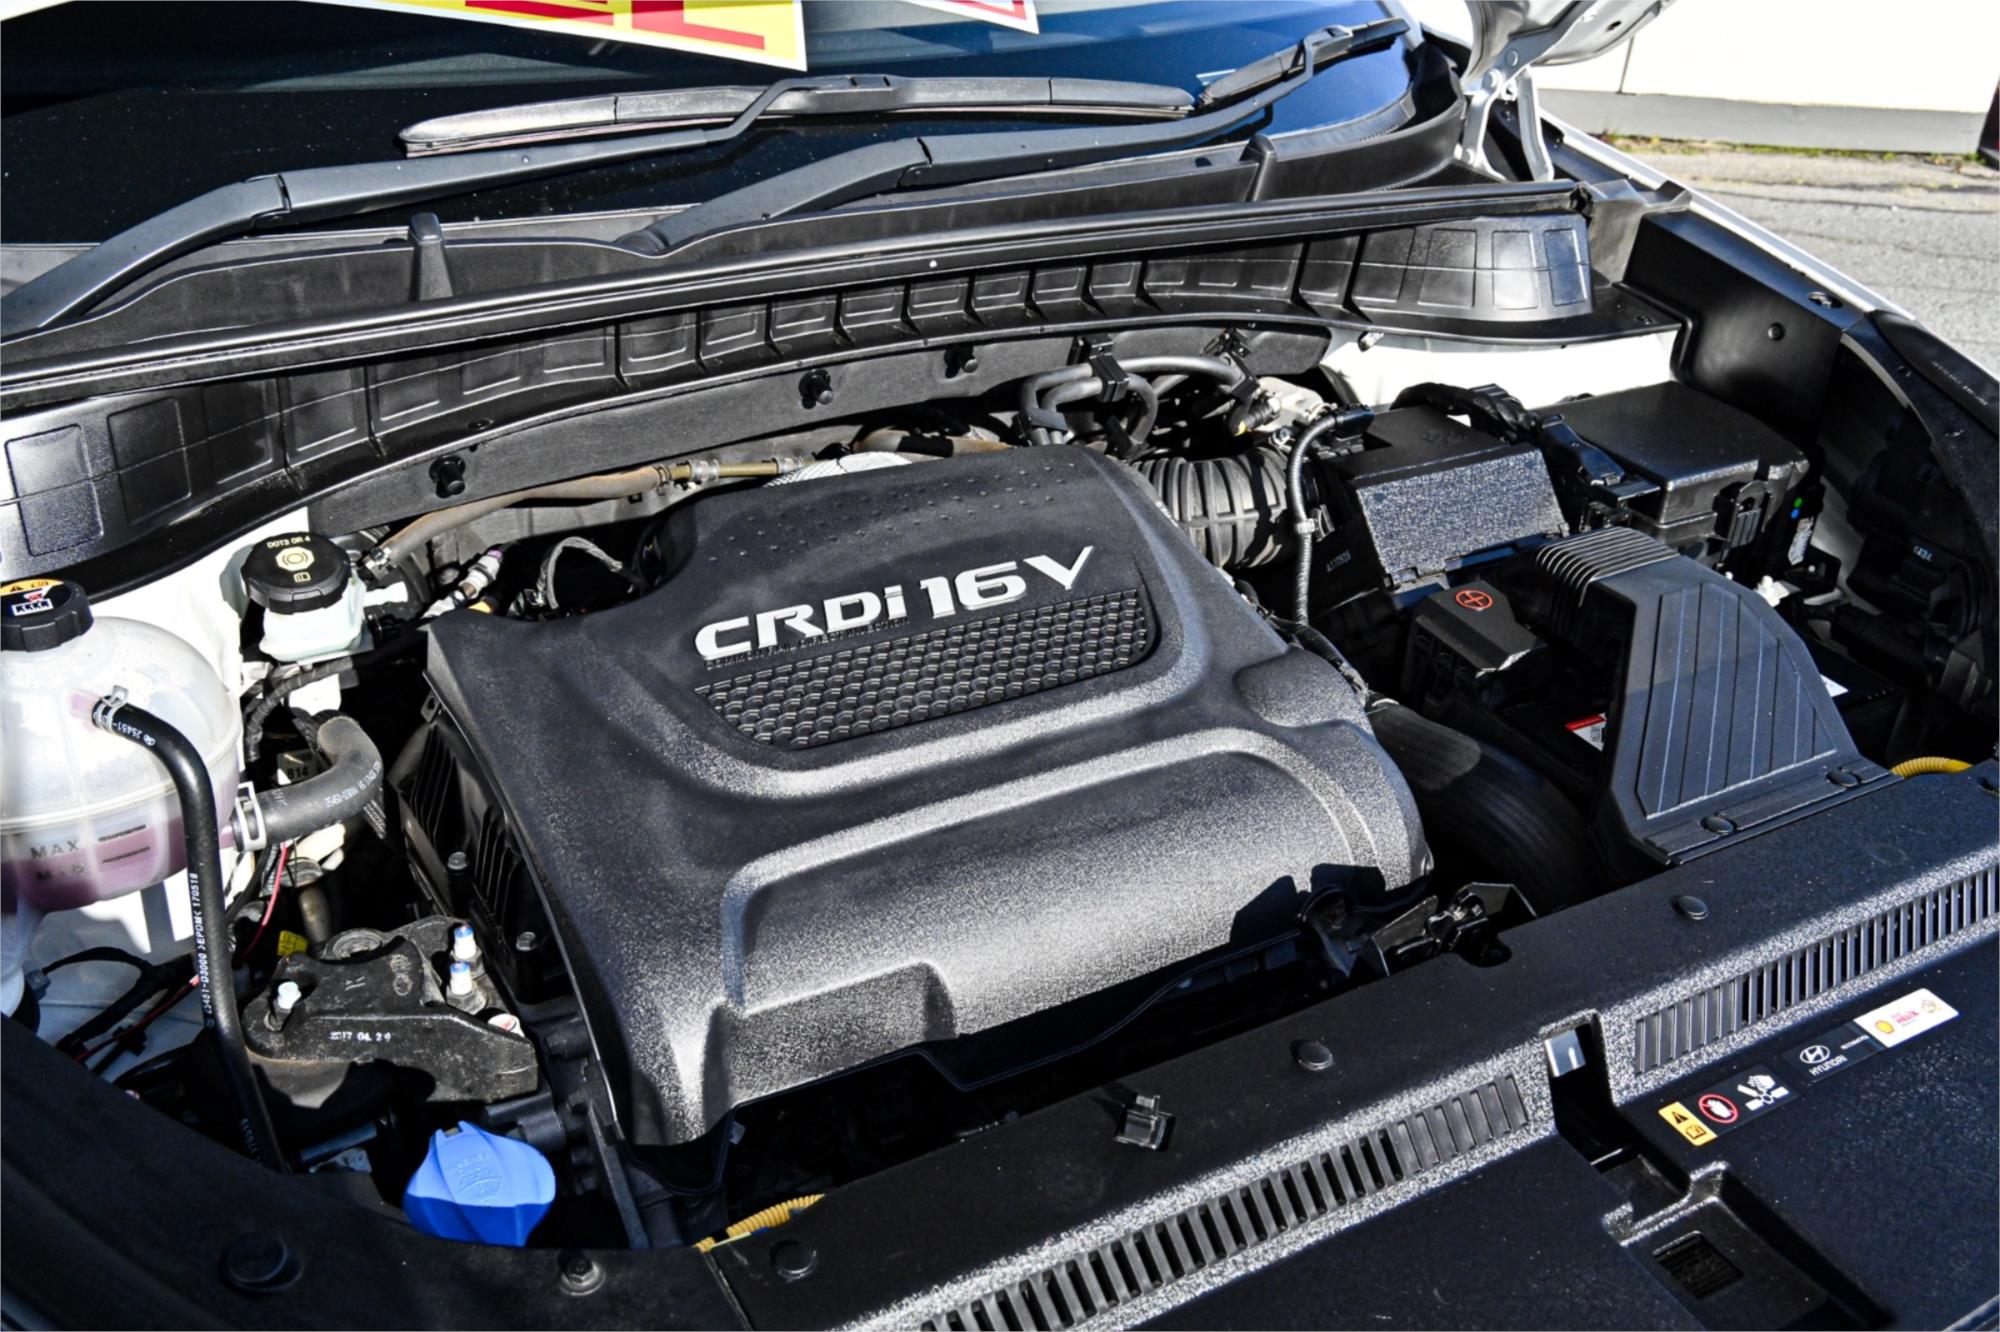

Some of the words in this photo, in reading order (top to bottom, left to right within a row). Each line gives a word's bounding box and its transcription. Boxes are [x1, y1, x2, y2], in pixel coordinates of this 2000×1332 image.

[266, 539, 290, 549] DOT3
[290, 536, 304, 545] OR
[695, 584, 908, 661] CRDi
[920, 545, 1094, 619] 16V
[30, 840, 80, 858] MAX
[1809, 1054, 1848, 1077] HYUNDAI
